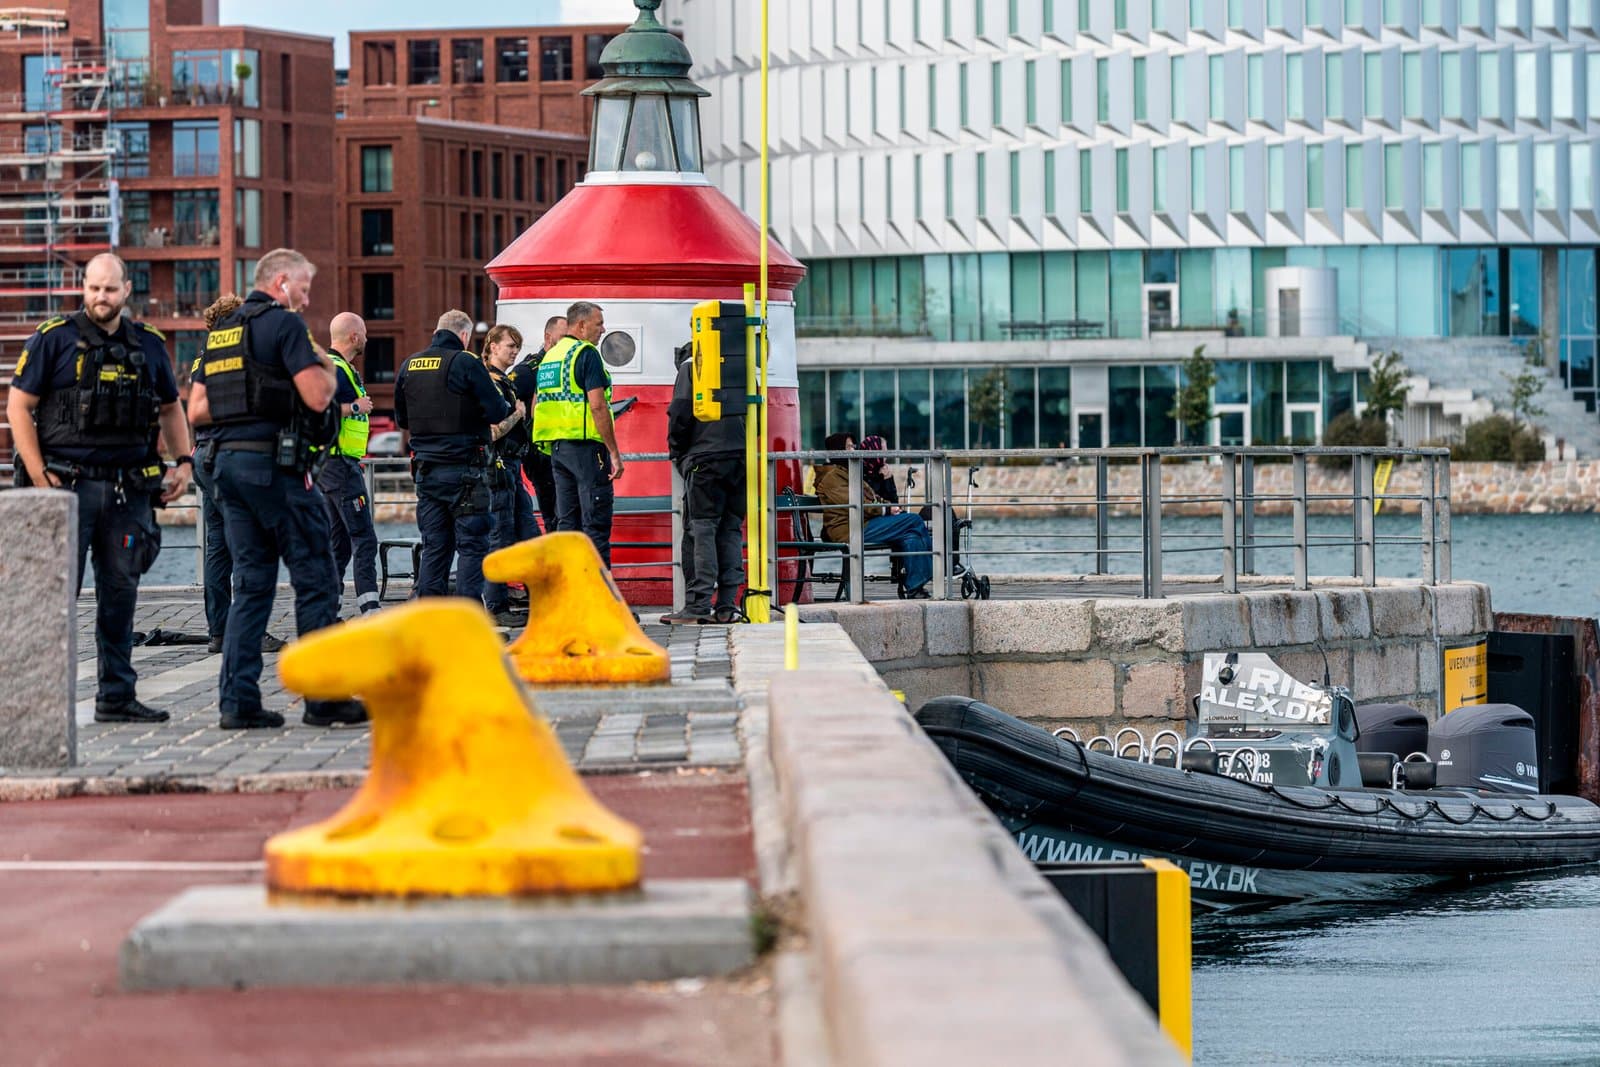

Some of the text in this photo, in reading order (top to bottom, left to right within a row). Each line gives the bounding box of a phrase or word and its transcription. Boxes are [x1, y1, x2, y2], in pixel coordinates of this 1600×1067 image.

[207, 330, 241, 346] POLITI
[409, 359, 440, 369] POLITI
[1200, 685, 1330, 723] ALEX.DK
